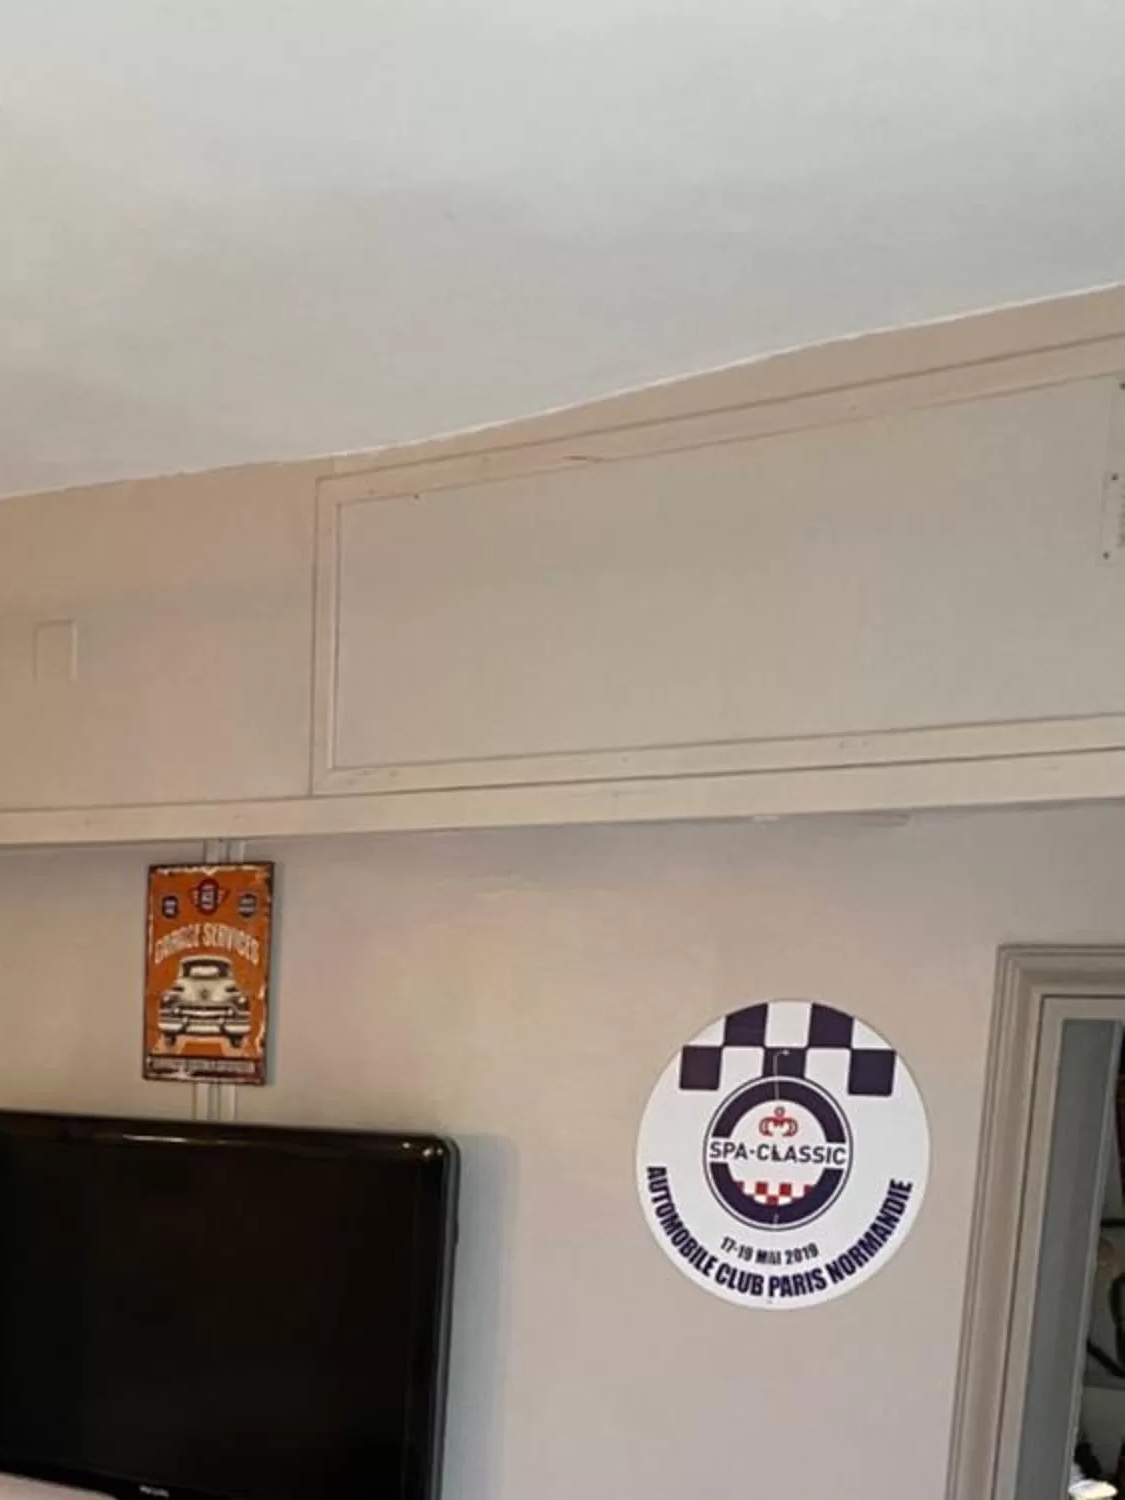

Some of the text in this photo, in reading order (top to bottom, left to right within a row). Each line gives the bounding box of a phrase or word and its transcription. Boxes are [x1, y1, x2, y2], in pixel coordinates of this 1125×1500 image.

[646, 1166, 914, 1298] AUTOMOBILE CLUB PARIS NORMANDIE
[783, 1241, 820, 1265] 2019
